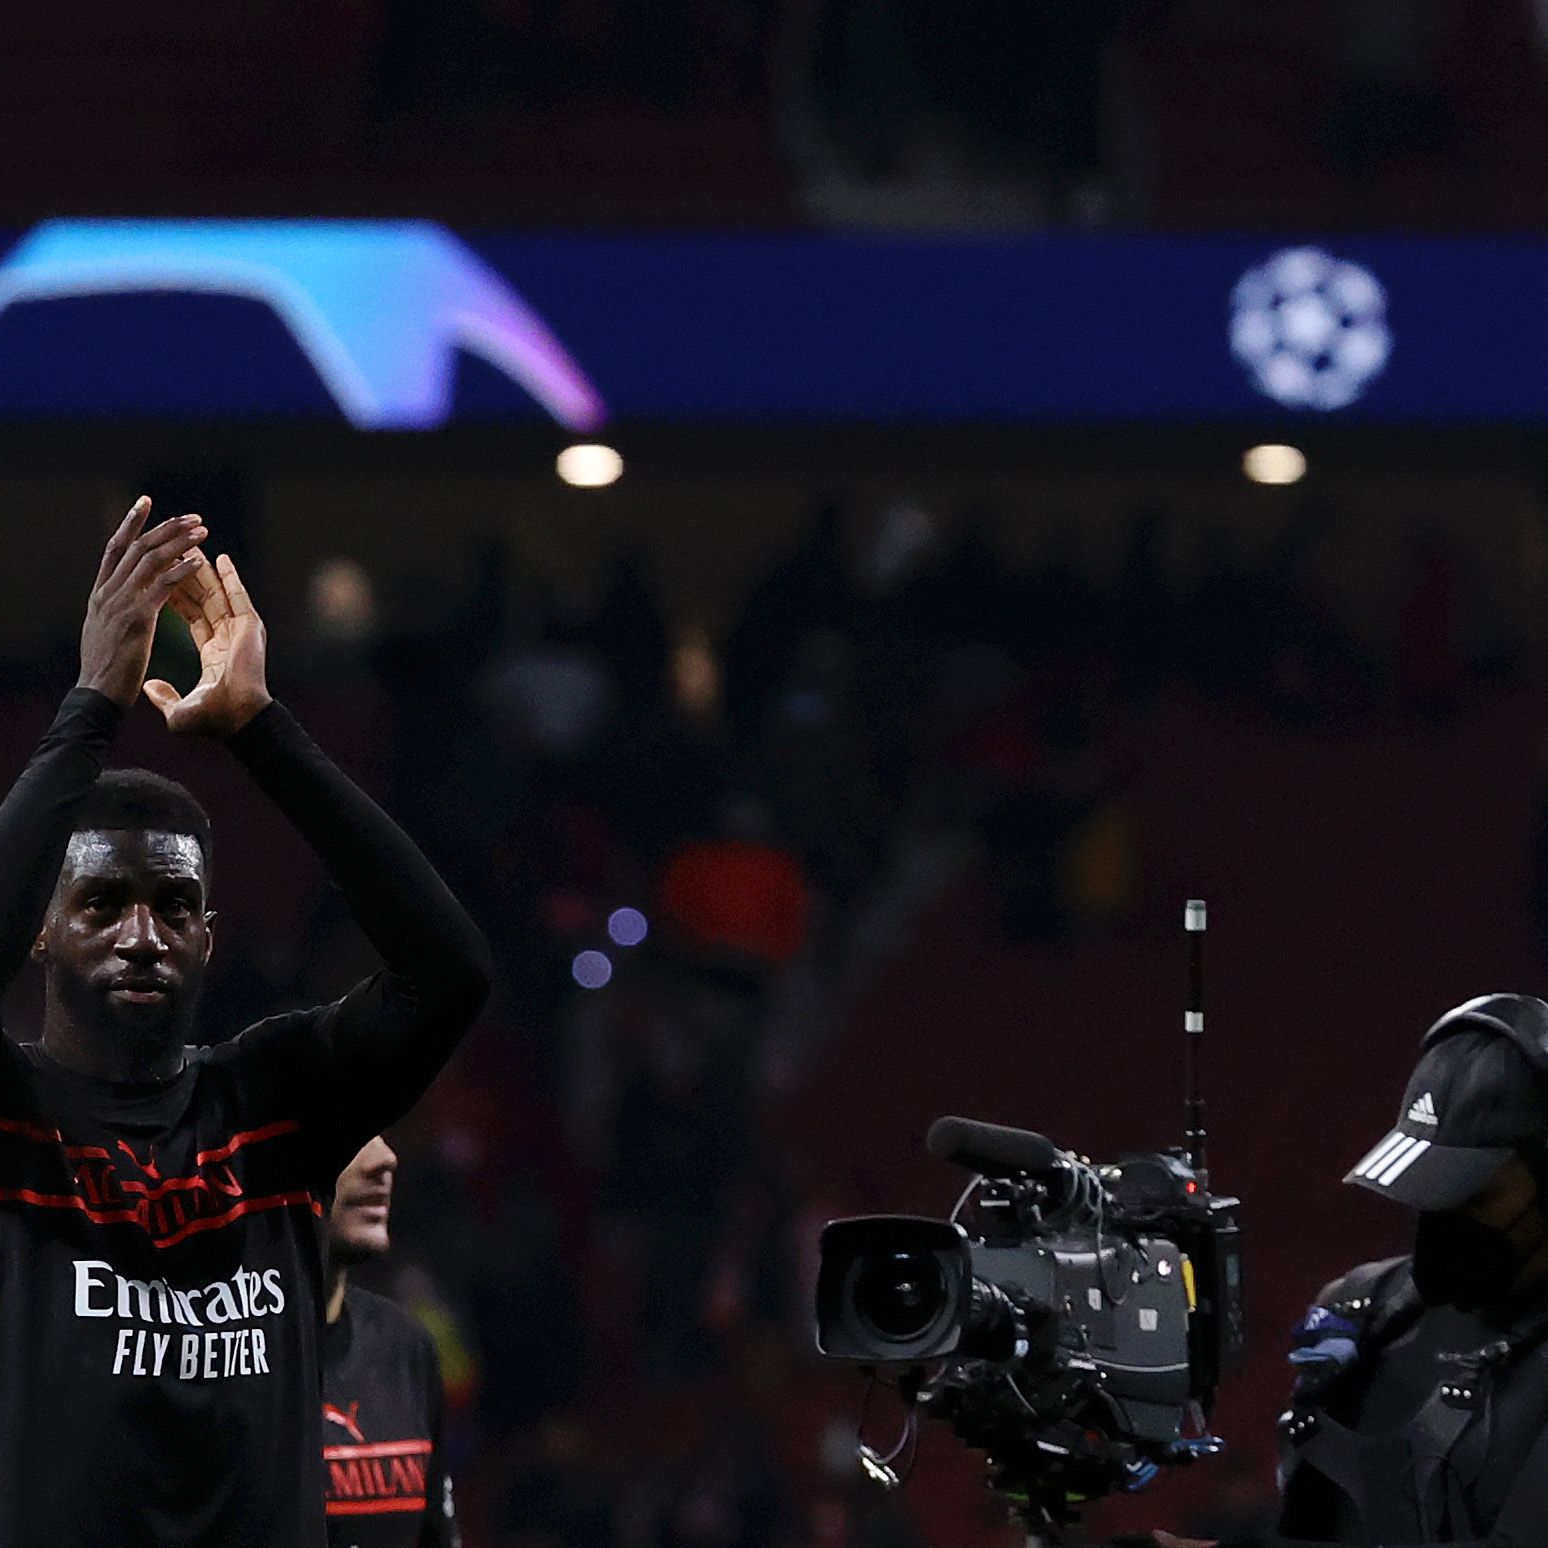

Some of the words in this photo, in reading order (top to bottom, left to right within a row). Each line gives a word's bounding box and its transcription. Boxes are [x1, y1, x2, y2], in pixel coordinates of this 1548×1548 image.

[72, 1259, 285, 1327] Emirates
[112, 1329, 171, 1377] FLY
[179, 1328, 270, 1380] BETTER
